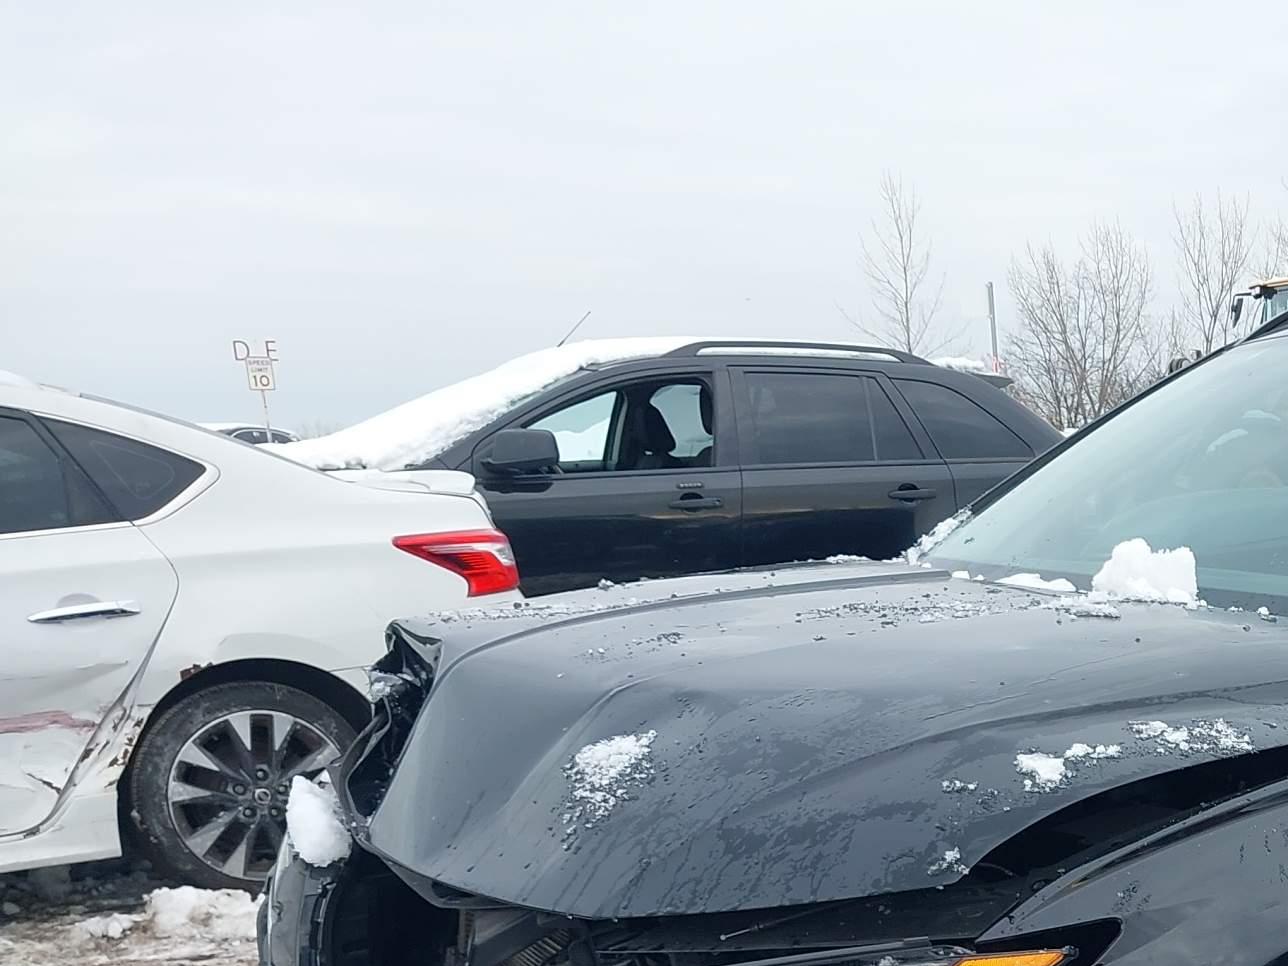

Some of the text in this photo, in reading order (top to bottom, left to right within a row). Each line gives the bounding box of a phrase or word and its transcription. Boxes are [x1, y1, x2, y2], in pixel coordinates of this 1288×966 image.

[233, 340, 280, 361] D E
[253, 374, 270, 387] 10
